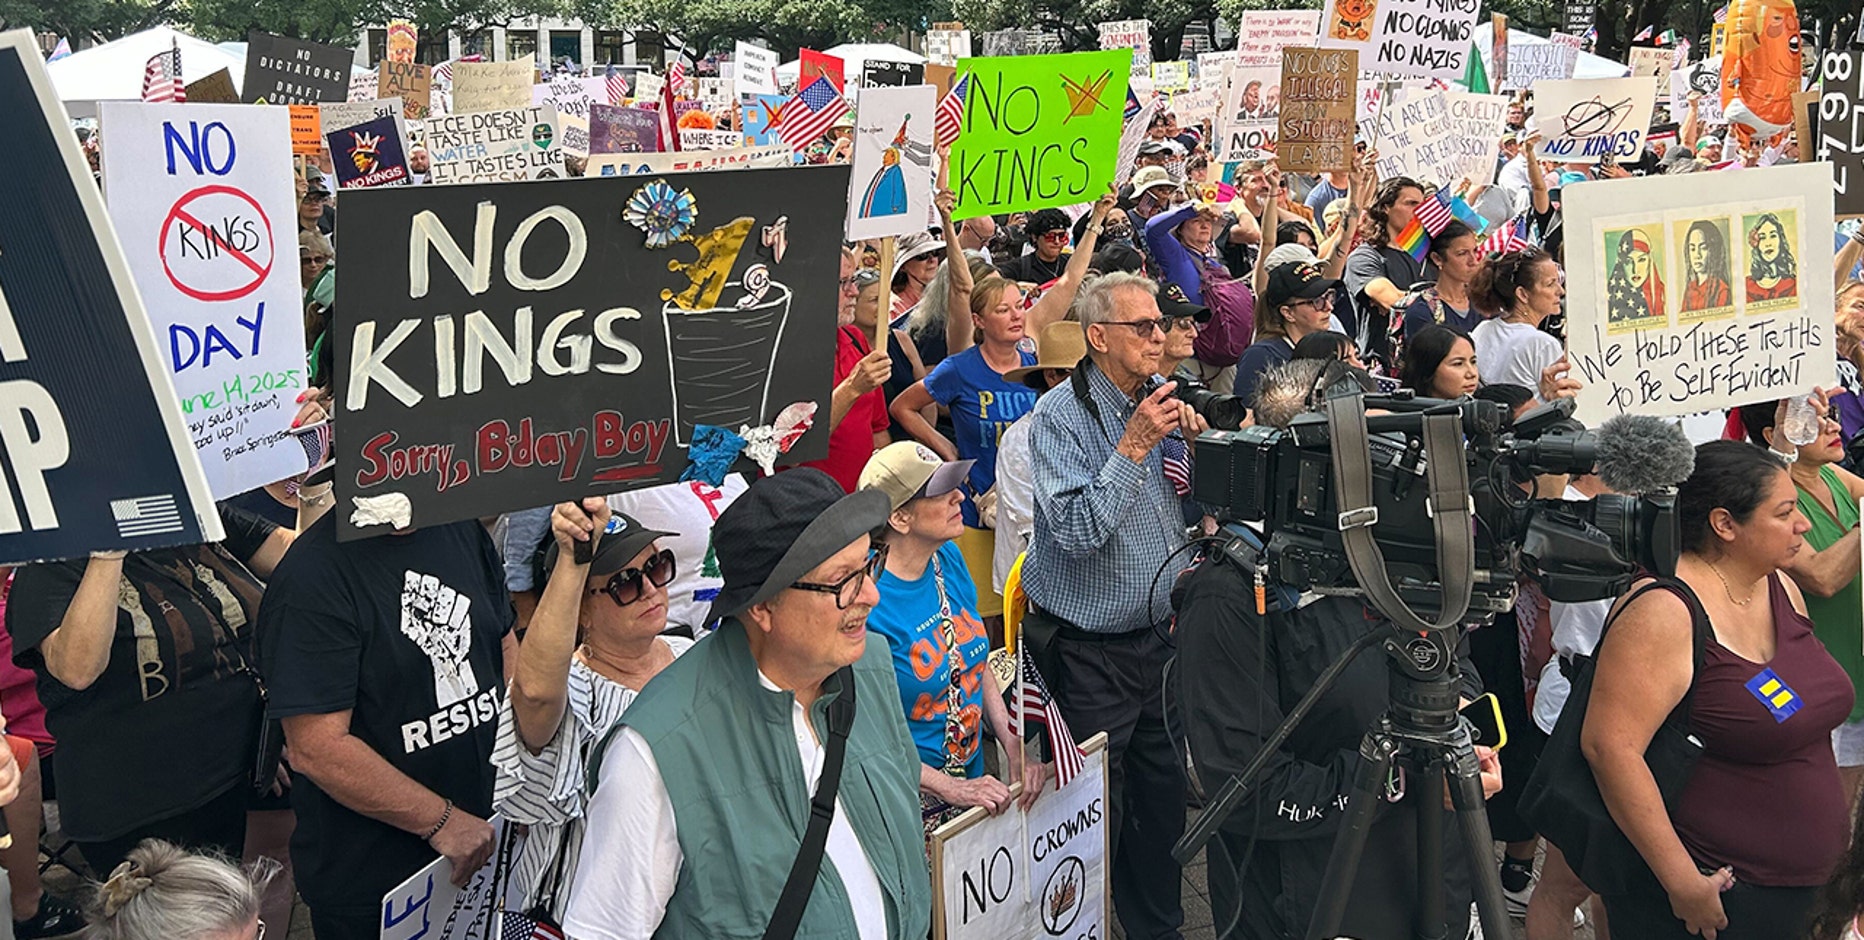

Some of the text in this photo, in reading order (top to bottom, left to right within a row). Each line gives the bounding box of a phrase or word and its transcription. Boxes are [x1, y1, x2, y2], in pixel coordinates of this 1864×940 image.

[1567, 6, 1583, 14] THIS
[1100, 23, 1120, 35] THIS
[1132, 21, 1146, 32] THE
[1383, 10, 1472, 42] NO CLOWNS
[296, 49, 311, 62] NO
[864, 60, 911, 73] STAND FOR
[1284, 52, 1306, 75] NO
[1377, 40, 1462, 70] NO NAZIS
[260, 56, 343, 82] DICTATORS
[388, 61, 424, 79] LOVE
[276, 81, 322, 100] DRAFT
[386, 75, 421, 93] ALL
[1287, 76, 1348, 99] ILLEGAL
[967, 71, 1040, 136] NO
[1452, 100, 1505, 121] CRUELTY
[428, 107, 542, 136] ICE DOESN'T
[1360, 104, 1425, 143] THEY ARE
[162, 121, 237, 176] NO
[430, 125, 525, 150] TASTE LIKE
[683, 133, 714, 146] WHERE
[1388, 131, 1413, 150] THE
[1545, 130, 1641, 158] NO KINGS
[431, 143, 488, 163] WATER
[433, 148, 564, 180] IT TASTES LIKE
[1228, 150, 1260, 160] KINGS
[1376, 143, 1439, 181] THEY ARE
[345, 166, 404, 190] NO KINGS
[957, 137, 1091, 208] KINGS
[178, 215, 261, 260] KINGS
[409, 201, 588, 300] NO
[169, 301, 266, 374] DAY
[345, 305, 643, 411] KINGS
[1570, 325, 1622, 384] We
[1635, 328, 1681, 368] HOLD
[249, 369, 301, 394] 2025
[1606, 382, 1634, 415] to
[1635, 370, 1662, 405] Be
[207, 406, 234, 428] said
[355, 430, 471, 493] Sorry,
[592, 409, 671, 465] Boy
[1033, 798, 1102, 862] CROWNS
[962, 846, 1014, 925] NO
